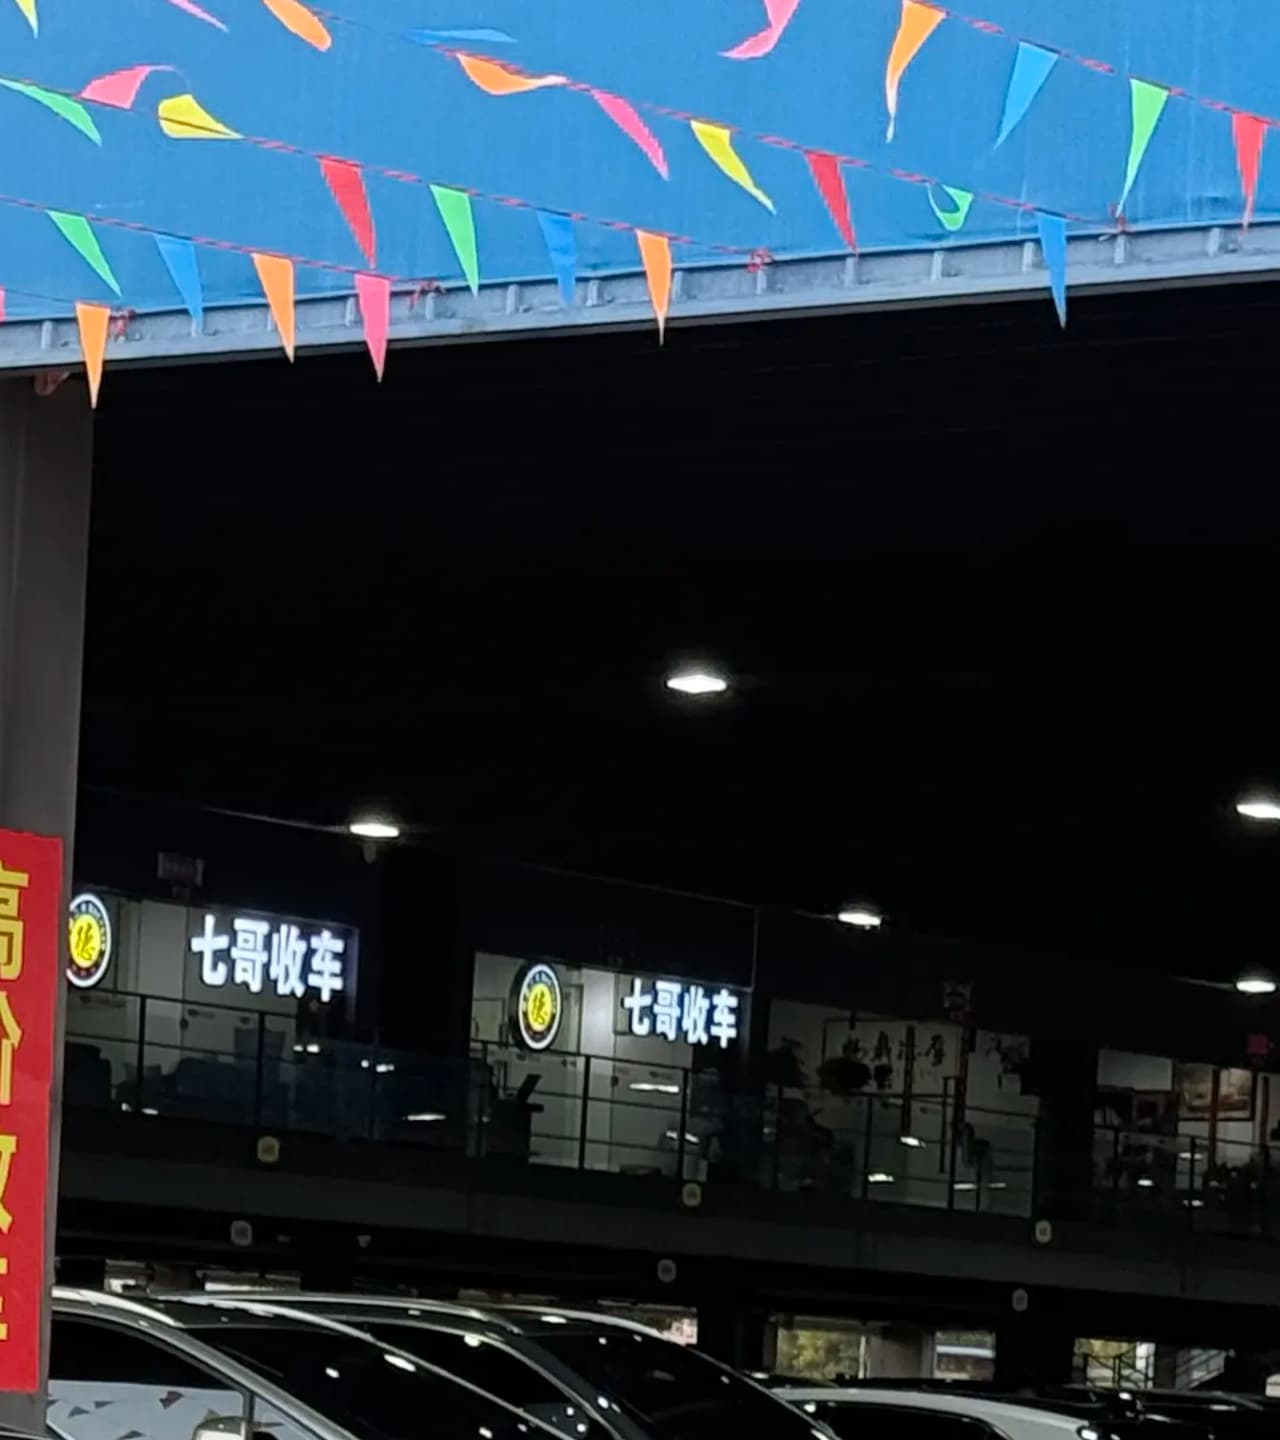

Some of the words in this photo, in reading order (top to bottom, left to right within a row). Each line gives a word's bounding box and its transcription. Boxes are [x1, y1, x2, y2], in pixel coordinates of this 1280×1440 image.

[191, 914, 345, 1002] 七哥收车
[624, 978, 739, 1049] 七哥收车
